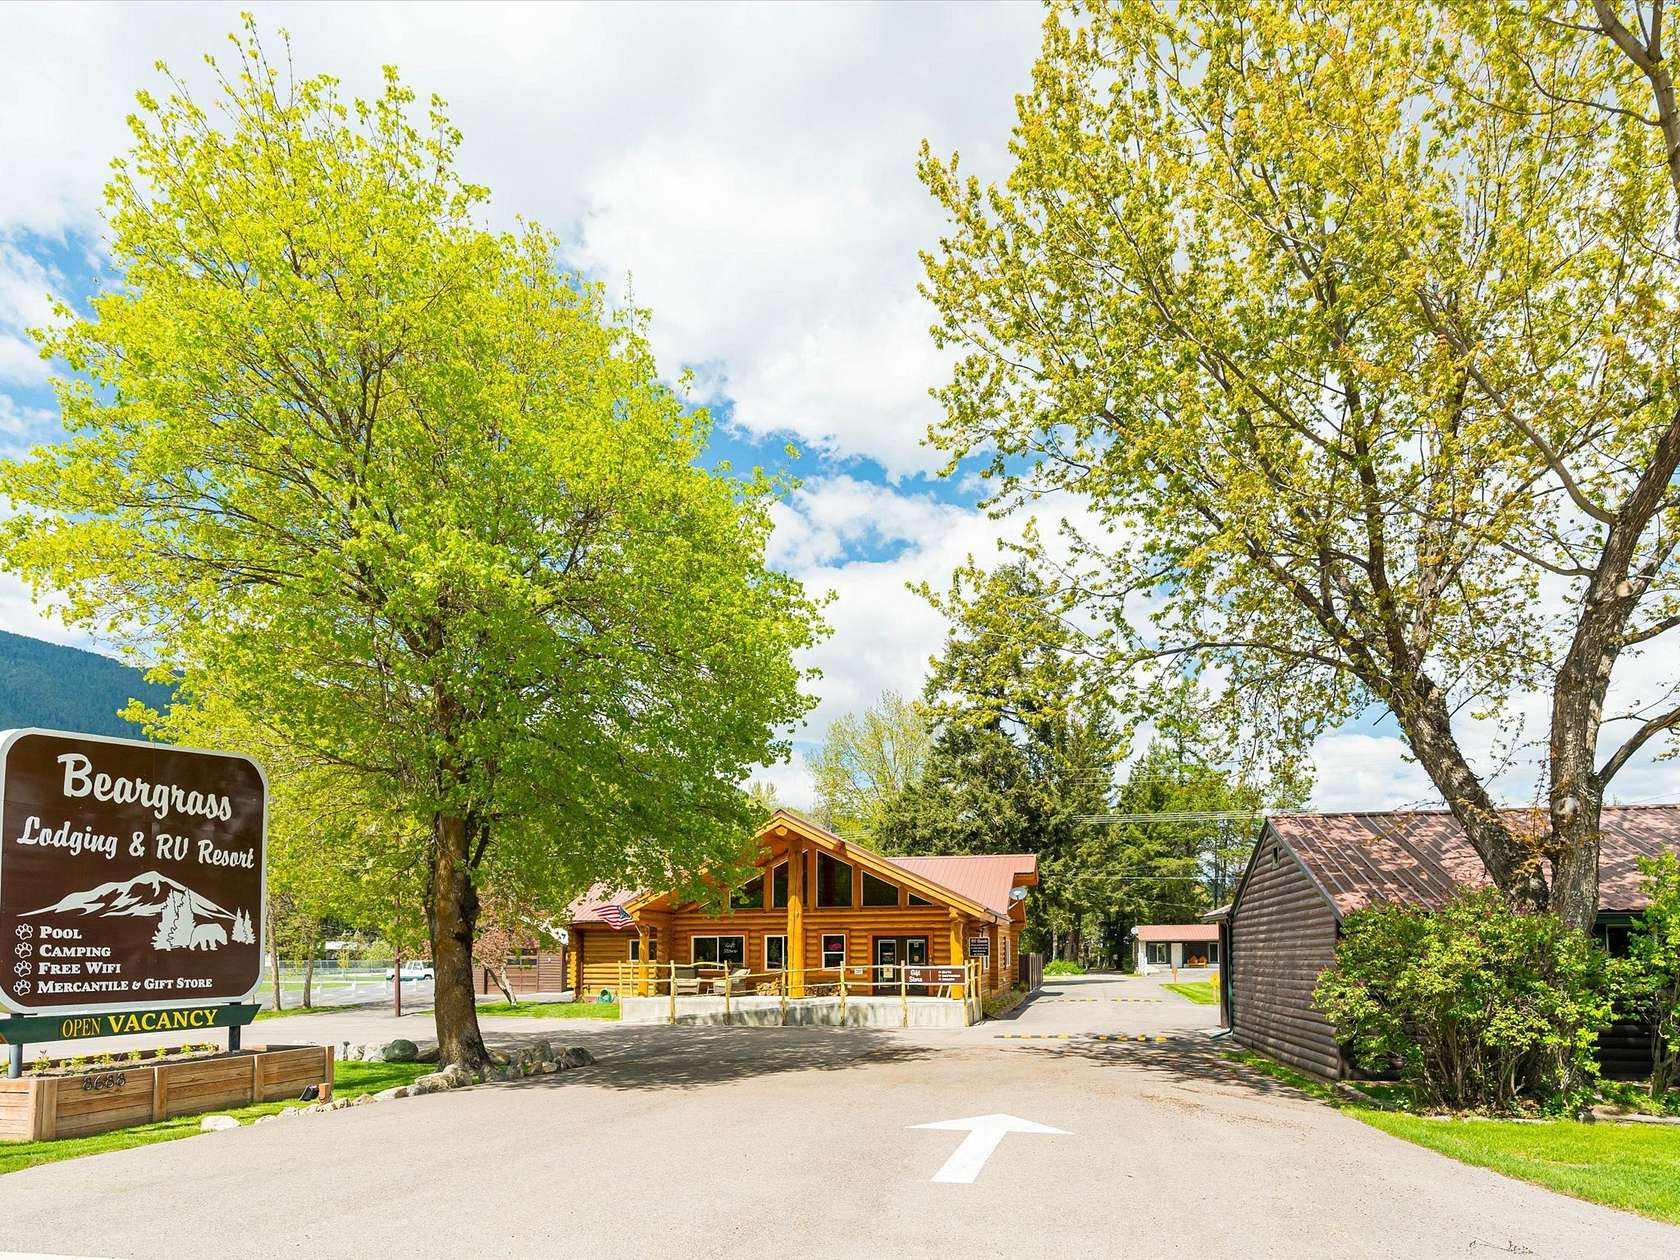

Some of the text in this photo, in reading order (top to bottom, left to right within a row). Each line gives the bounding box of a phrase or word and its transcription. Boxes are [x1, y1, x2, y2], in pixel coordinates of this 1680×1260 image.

[57, 753, 232, 821] Beargrass
[17, 816, 254, 869] Lodging & RV Resort
[131, 981, 141, 991] &
[62, 1009, 218, 1038] OPEN VACANCY
